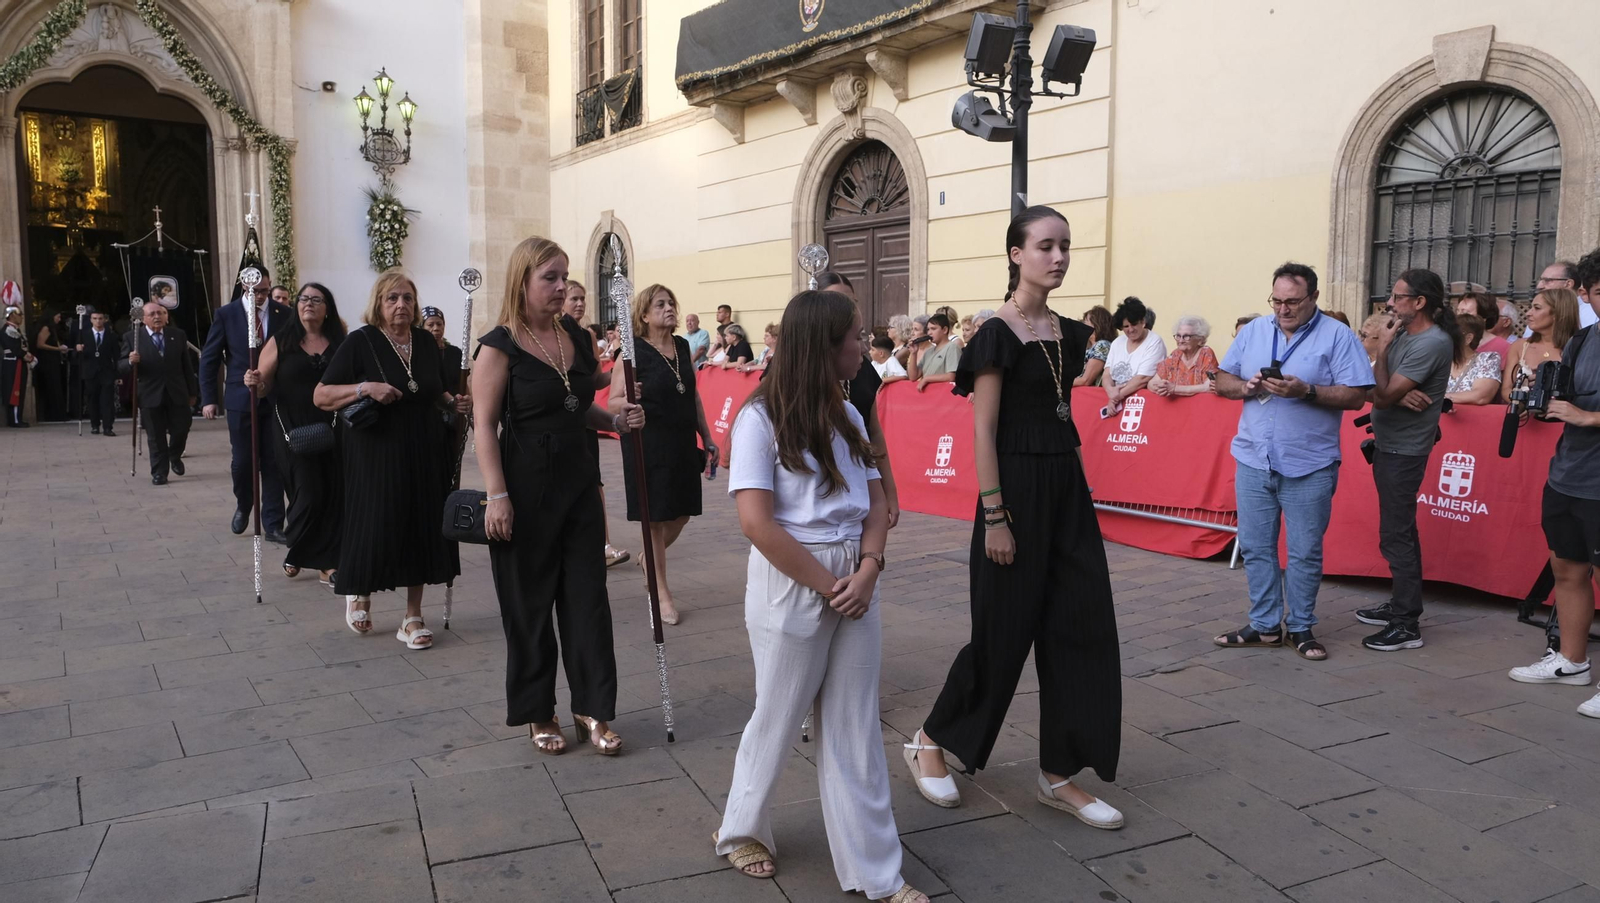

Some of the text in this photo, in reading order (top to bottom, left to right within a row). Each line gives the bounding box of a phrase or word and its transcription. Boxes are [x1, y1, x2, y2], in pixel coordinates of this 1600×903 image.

[1106, 433, 1148, 445] ALMERÍA
[1112, 445, 1137, 453] CIUDAD
[924, 467, 956, 477] ALMERÍA
[1416, 493, 1489, 515] ALMERÍA
[453, 503, 475, 531] B
[1430, 508, 1471, 523] CIUDAD
